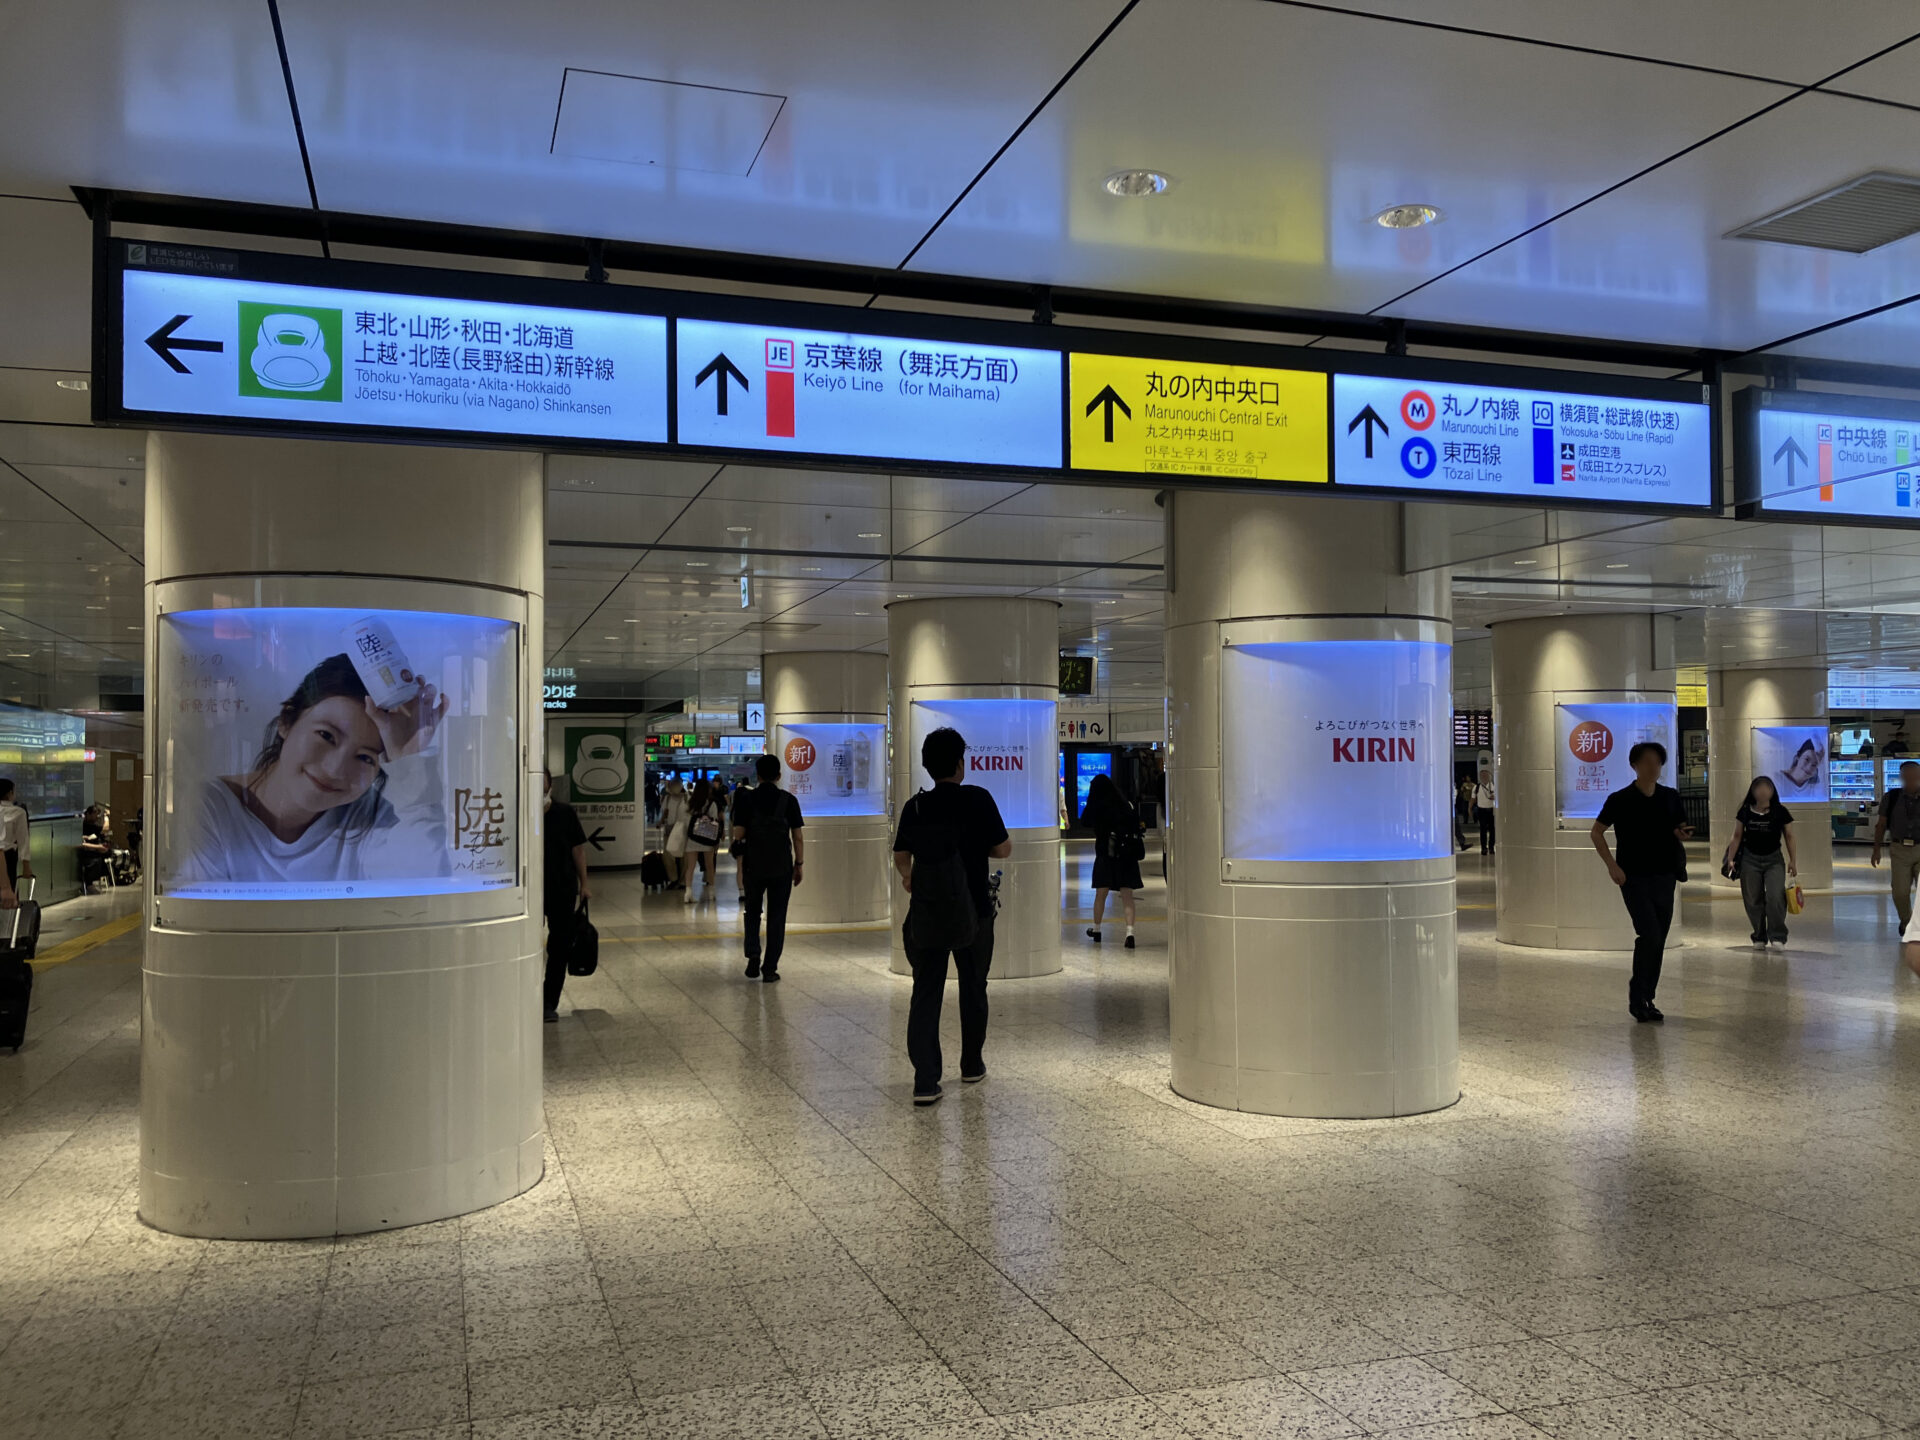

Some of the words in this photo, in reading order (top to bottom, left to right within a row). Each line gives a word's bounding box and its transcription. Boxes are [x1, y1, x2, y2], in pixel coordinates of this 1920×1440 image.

[150, 247, 211, 260] にやさしい
[150, 257, 234, 272] LEDを用しています
[355, 311, 574, 350] 東北・山形・秋田・北海道
[354, 340, 615, 381] 上越・北陸(長野経由)新幹線
[771, 346, 788, 361] JE
[804, 342, 883, 372] 京葉線
[899, 349, 1019, 384] (舞浜方面)
[804, 373, 847, 392] Keiyō
[852, 376, 884, 392] Line
[899, 378, 924, 396] (for
[929, 382, 1000, 402] Maihama)
[1145, 371, 1280, 406] 丸の内中央口
[463, 392, 485, 408] (via
[488, 394, 540, 412] Nagano)
[543, 398, 612, 415] Shinkansen
[1442, 393, 1520, 421] 丸ノ内線
[1145, 403, 1216, 422] Marunouchi
[1219, 408, 1262, 425] Central
[1266, 412, 1288, 428] Exit
[1535, 408, 1550, 420] JO
[1560, 403, 1680, 431] 横須賀・総武線(快速)
[1146, 424, 1234, 442] 丸之内中央出口
[1442, 420, 1497, 435] Marunouchi
[1499, 424, 1519, 437] Line
[1820, 428, 1830, 438] JC
[1627, 430, 1643, 442] Line
[1645, 432, 1674, 446] (Rapid)
[1838, 426, 1888, 449] 中央線
[1898, 434, 1907, 444] JY
[1442, 440, 1502, 466] 東西線
[1578, 444, 1621, 459] 成田空港
[1867, 452, 1888, 465] Line
[1478, 468, 1503, 482] Line
[1578, 459, 1667, 477] (成田エクスプレス)
[1579, 474, 1597, 482] Narita
[1600, 475, 1620, 484] Airport
[1622, 476, 1642, 485] (Narita
[1644, 478, 1671, 487] Express)
[1899, 476, 1908, 486] JK
[544, 700, 568, 709] racks
[1333, 737, 1415, 762] KIRIN
[1575, 730, 1607, 754] 新!
[971, 755, 1023, 771] KIRIN
[1578, 765, 1606, 777] 8.25
[455, 787, 505, 851] 陸
[454, 858, 505, 873] ハイボール
